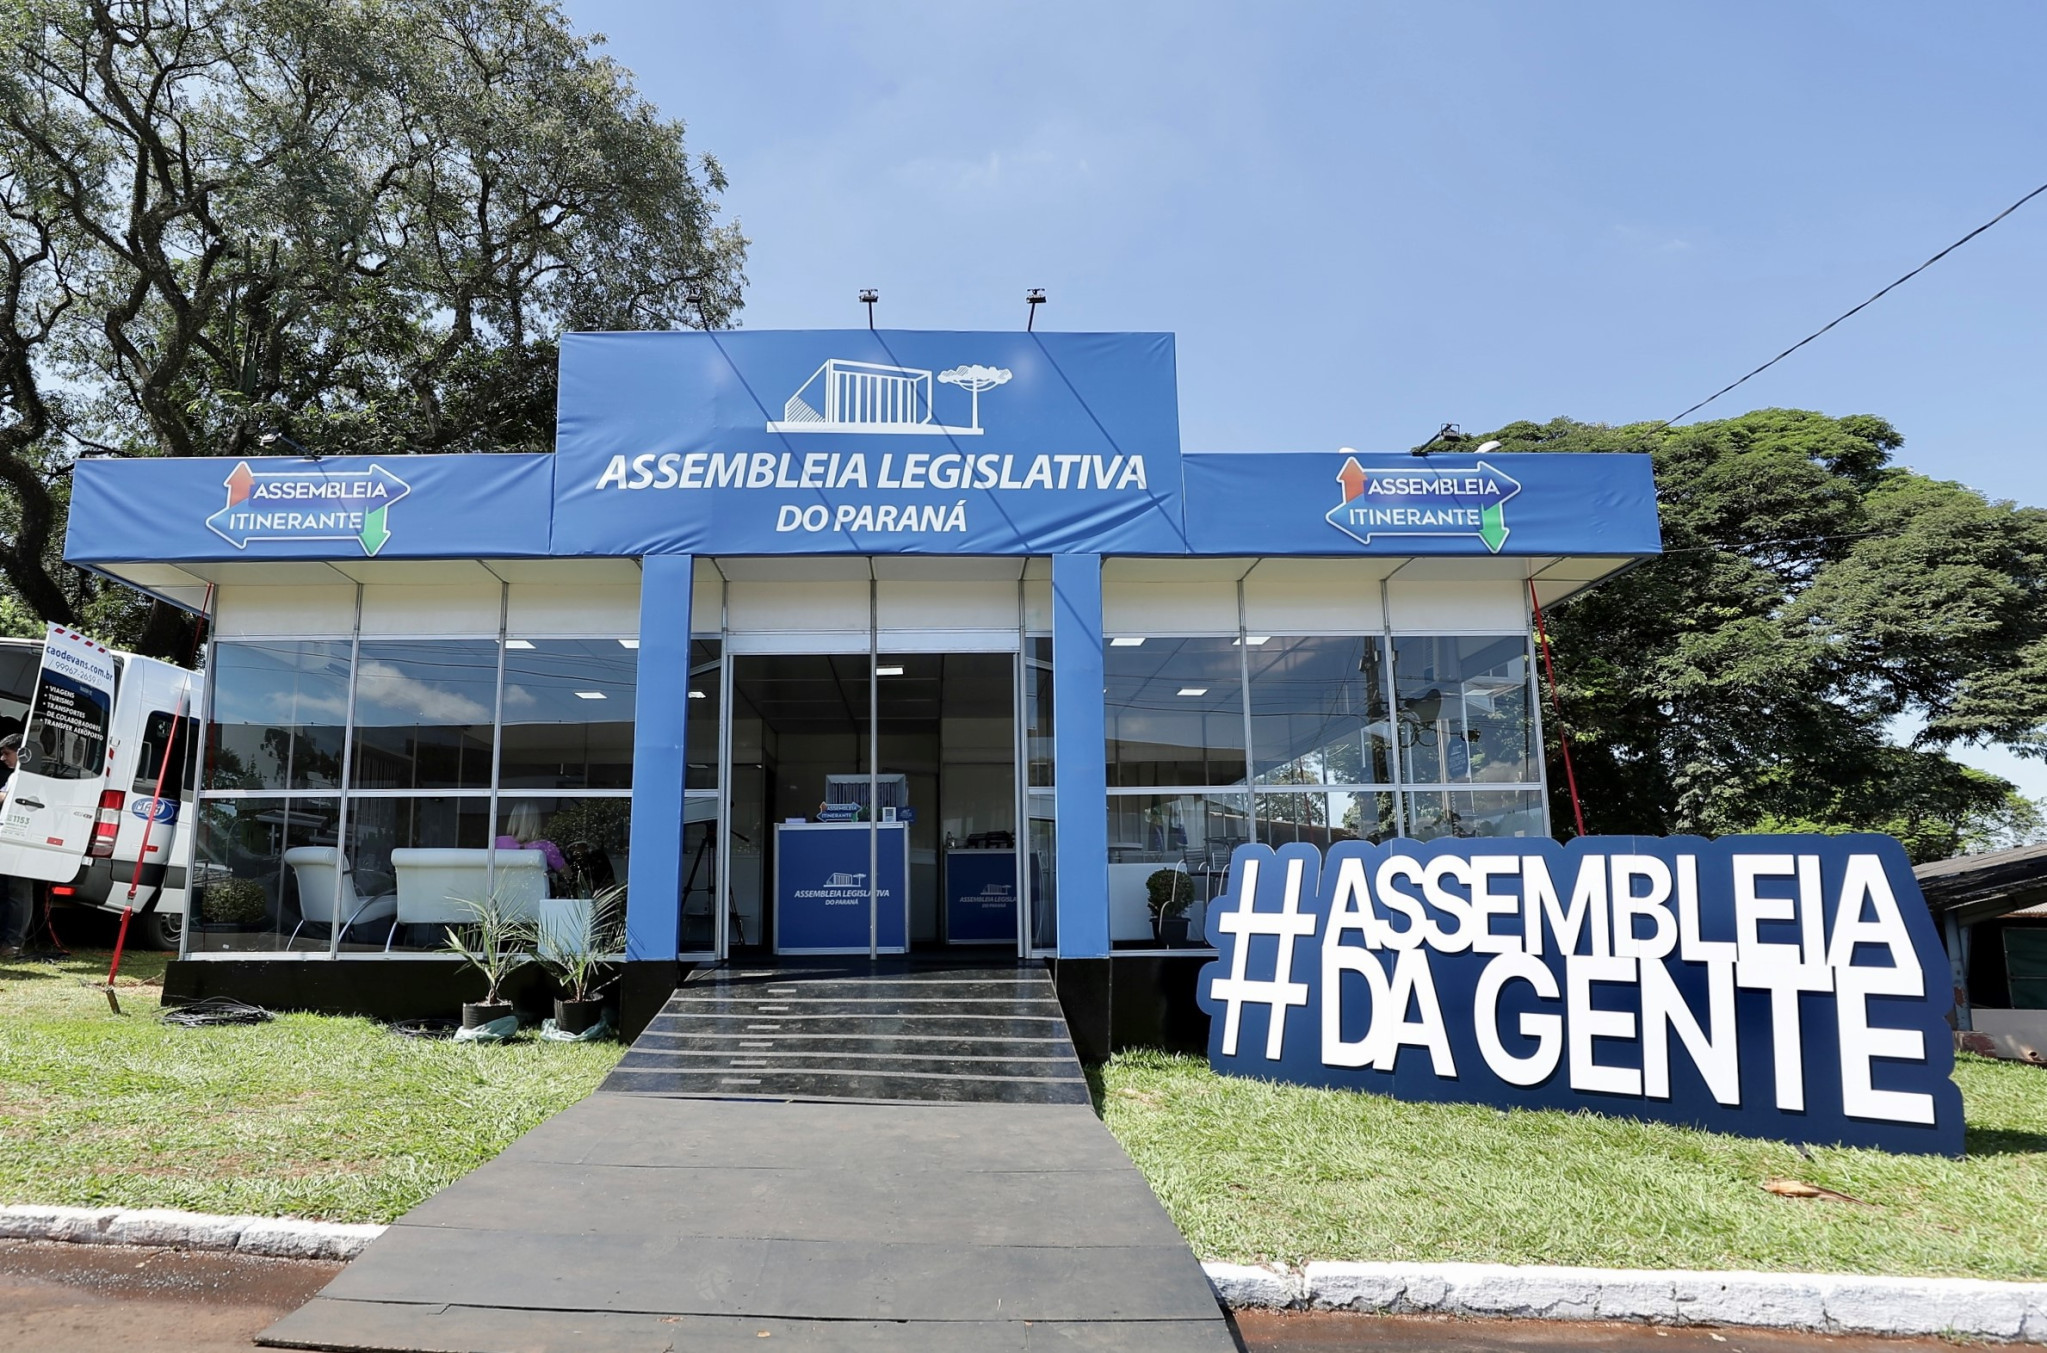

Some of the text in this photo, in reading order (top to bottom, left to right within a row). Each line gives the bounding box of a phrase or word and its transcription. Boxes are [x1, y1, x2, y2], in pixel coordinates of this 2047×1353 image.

[595, 452, 1147, 490] ASSEMBLEIA LEGISLATIVA
[253, 481, 388, 499] ASSEMBLEIA
[1367, 478, 1501, 495] ASSEMBLEIA
[229, 512, 362, 530] ITINERANTE
[774, 499, 967, 532] DO PARANÁ
[1349, 509, 1481, 526] ITINERANTE
[48, 693, 74, 707] TURISMO
[49, 685, 75, 699] VIAGENS
[47, 702, 86, 719] TRANSPORTES
[44, 718, 73, 732] TRANSFER
[46, 710, 101, 732] DE COLABORADORES
[827, 803, 857, 811] ASSEMBLEIA
[794, 889, 842, 898] ASSEMBLEIA
[1321, 944, 1936, 1125] DA GENTE
